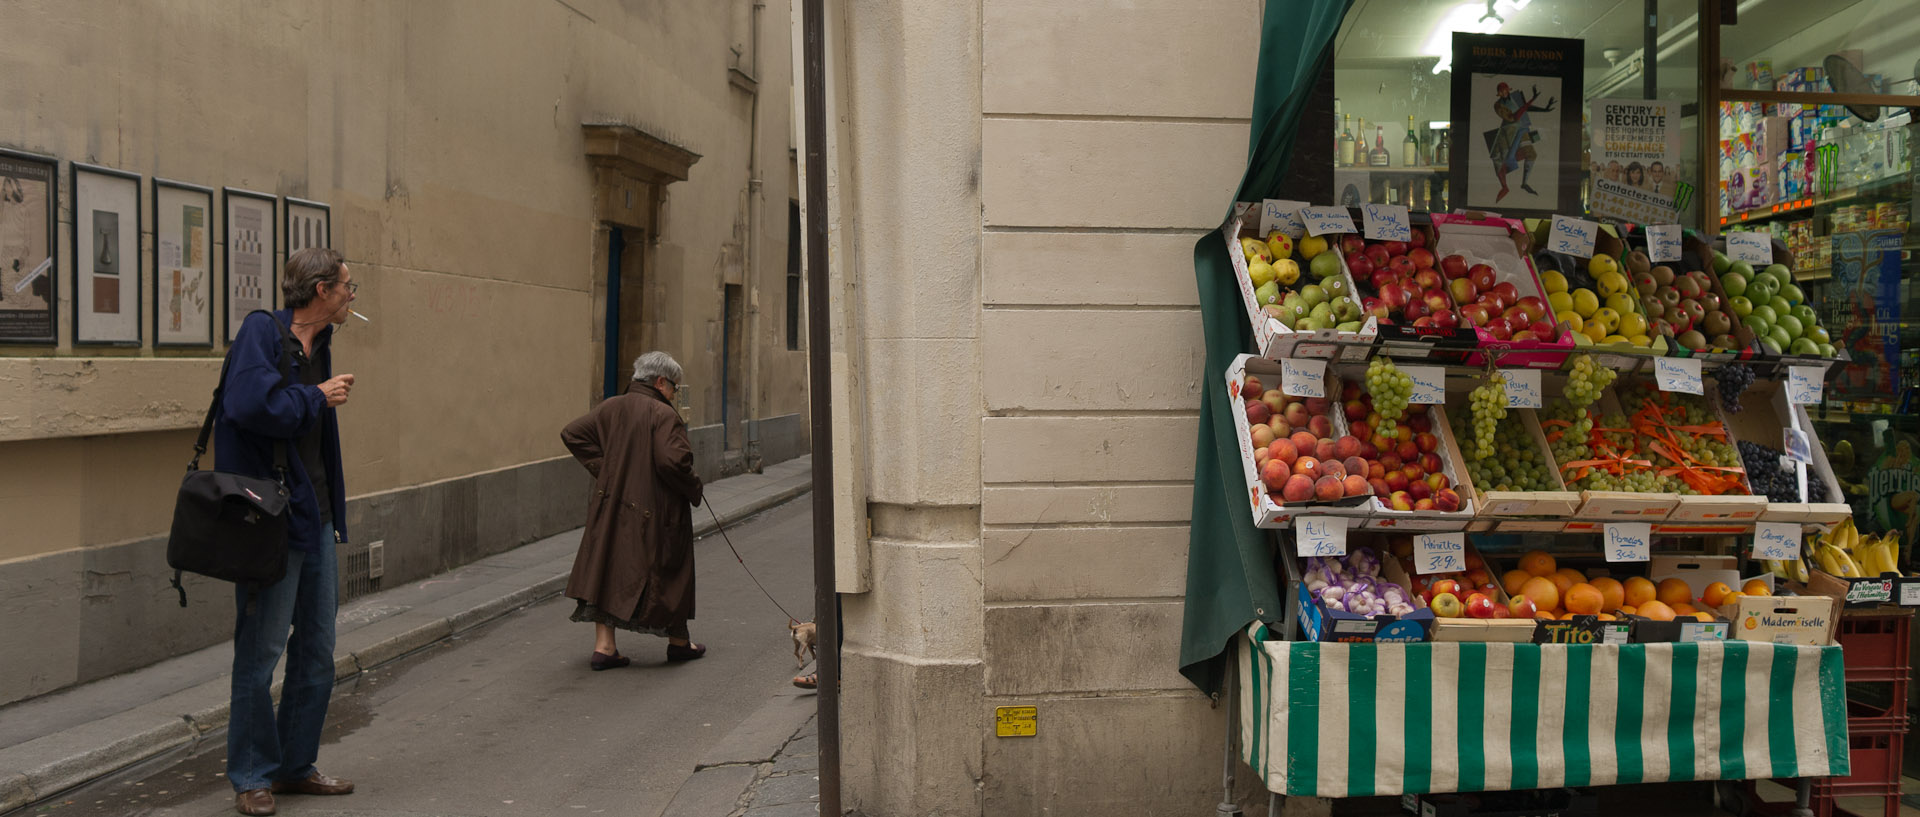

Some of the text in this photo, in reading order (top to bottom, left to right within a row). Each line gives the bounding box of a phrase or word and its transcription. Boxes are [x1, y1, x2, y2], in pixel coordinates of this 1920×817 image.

[1605, 105, 1666, 116] CENTURY 21
[1606, 115, 1665, 127] RECRUTE
[1605, 142, 1665, 152] CONFIANCE
[1597, 179, 1676, 208] Contactez-nou
[1869, 314, 1898, 344] Jung
[1429, 556, 1456, 570] 3€90
[1761, 616, 1825, 628] Mademoiselle
